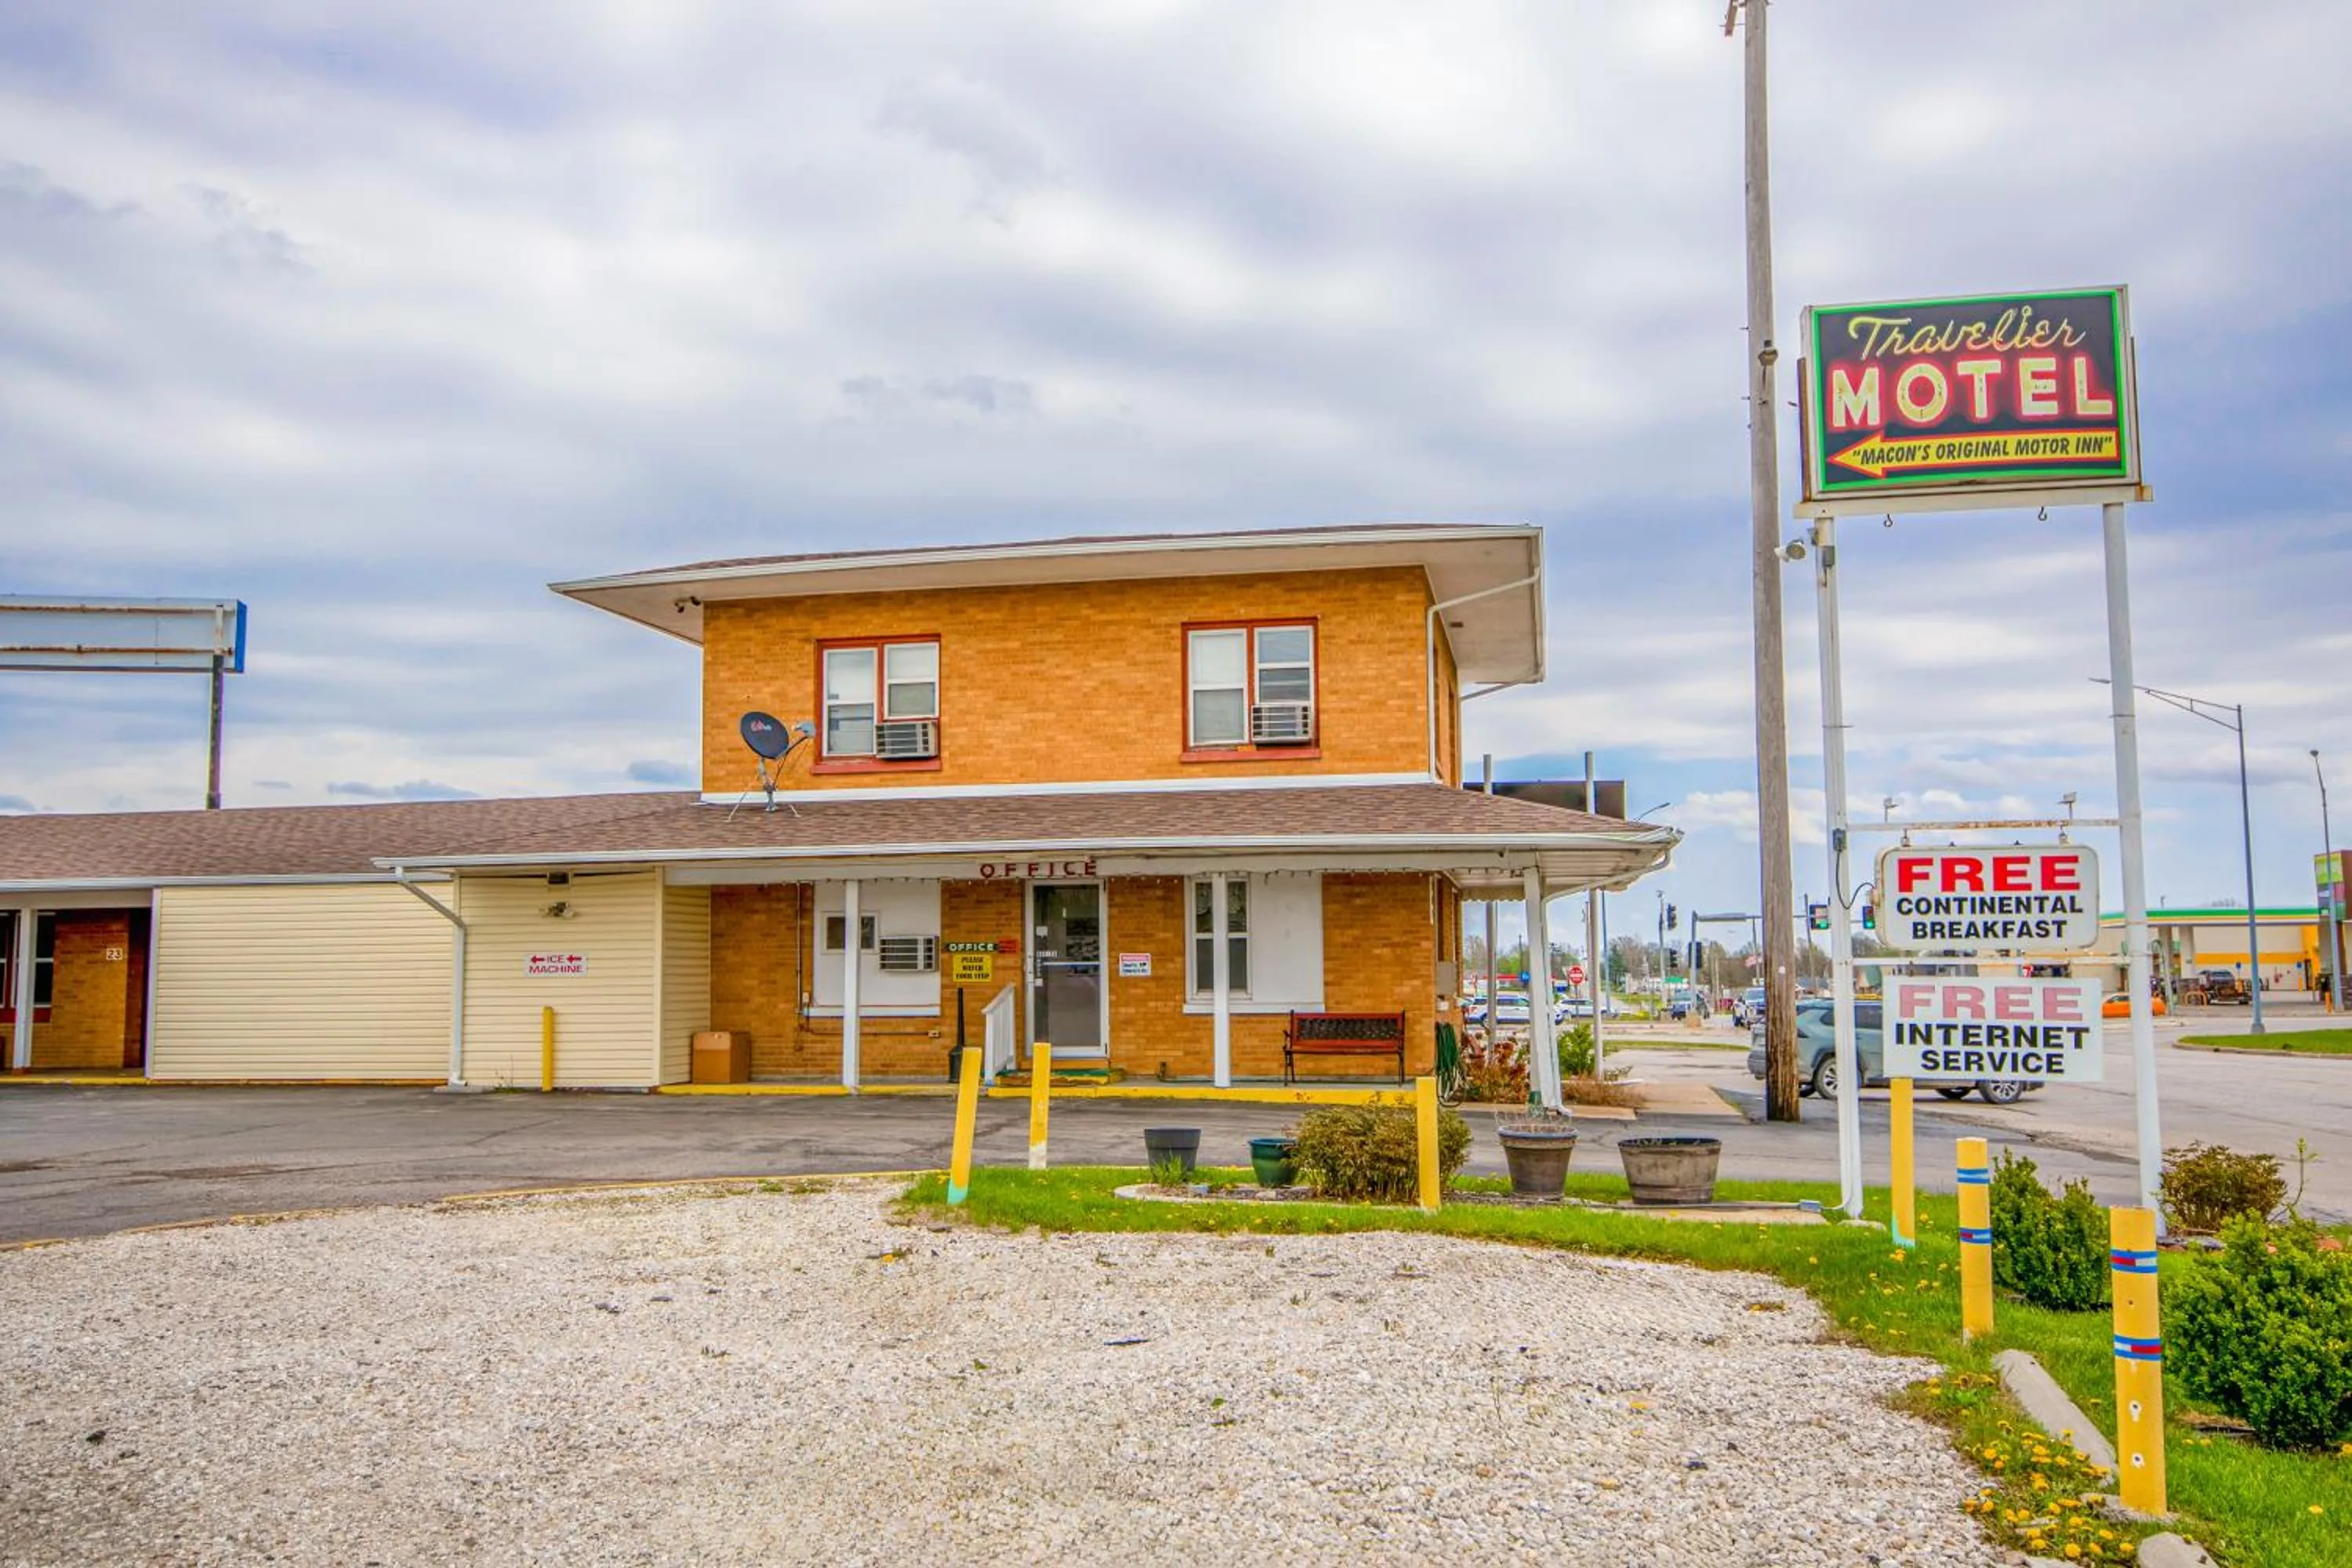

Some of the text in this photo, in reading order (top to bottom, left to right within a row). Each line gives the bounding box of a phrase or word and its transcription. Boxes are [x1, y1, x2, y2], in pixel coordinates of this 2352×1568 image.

[1832, 357, 2113, 427] MOTEL
[1935, 439, 2009, 461] ORIGINAL
[2014, 437, 2070, 456] MOTOR
[980, 860, 1097, 878] OFFICE
[1897, 855, 2082, 893] FREE
[1896, 895, 2084, 916] CONTINENTAL
[1911, 920, 2068, 940] BREAKFAST
[107, 949, 121, 959] 23
[949, 942, 995, 952] OFFICE
[528, 965, 584, 974] MACHINE
[546, 954, 565, 964] ICE
[1898, 984, 2084, 1022] FREE
[1894, 1022, 2091, 1050] INTERNET
[1920, 1050, 2066, 1075] SERVICE
